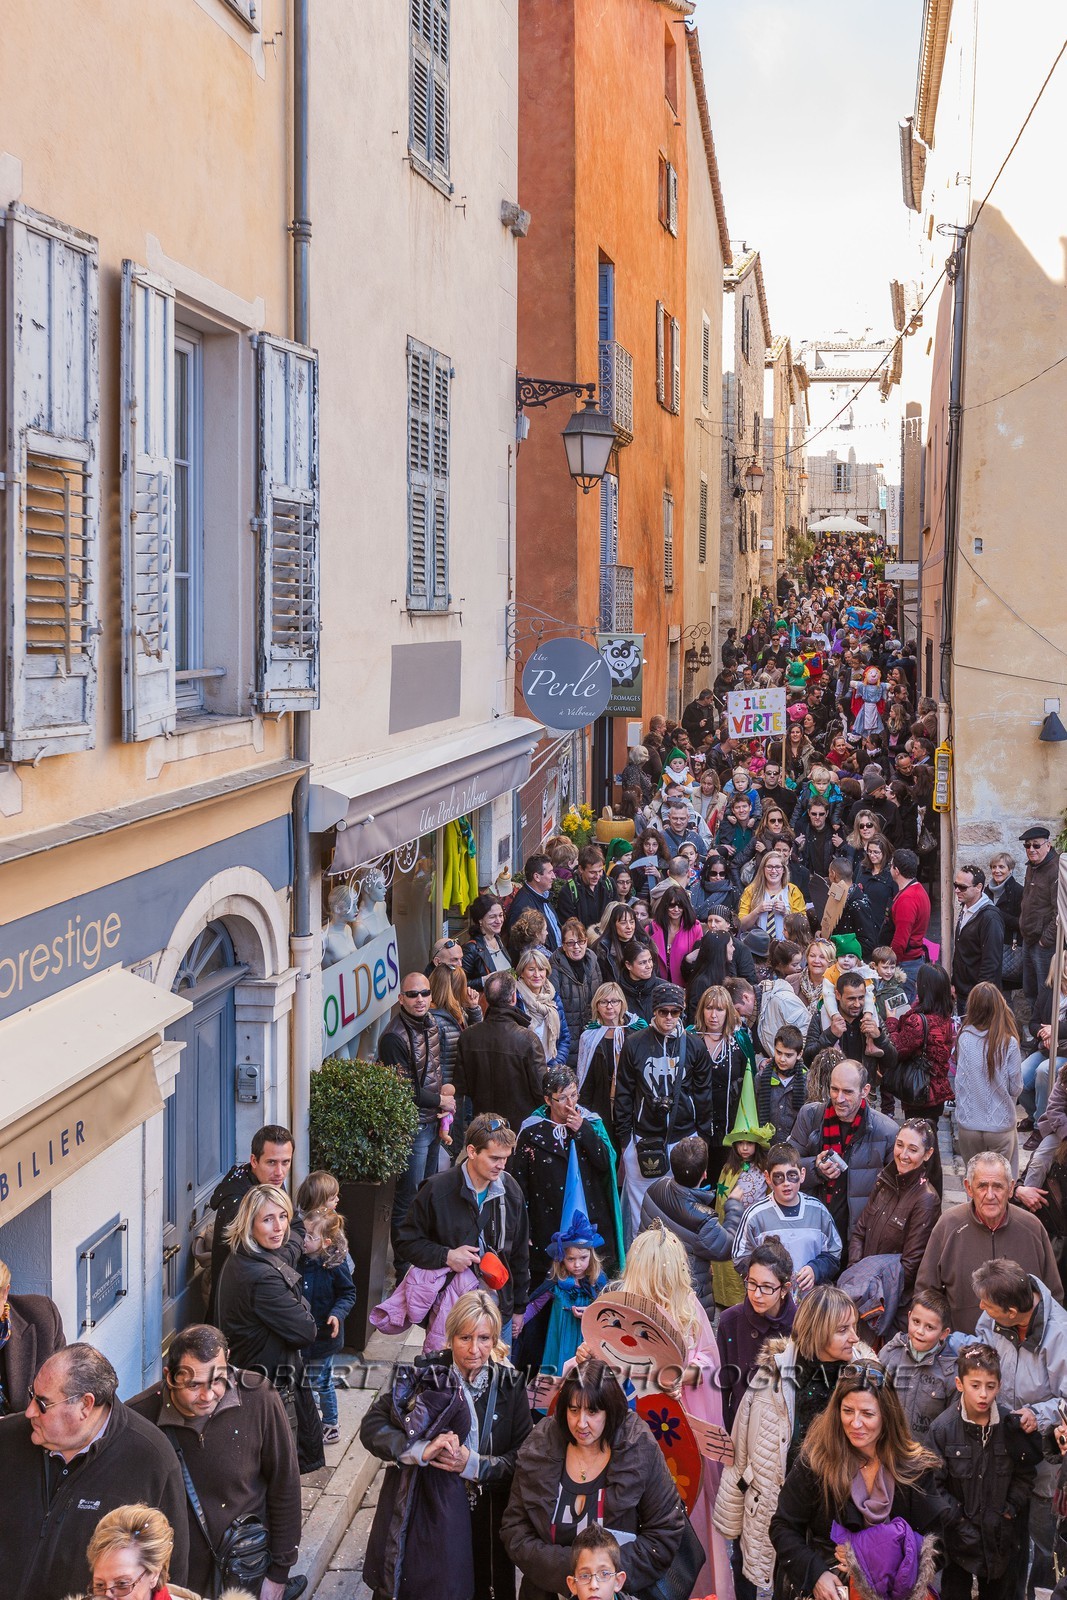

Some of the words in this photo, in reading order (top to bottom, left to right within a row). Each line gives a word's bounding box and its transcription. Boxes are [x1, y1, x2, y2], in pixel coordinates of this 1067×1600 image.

[533, 653, 548, 661] Une
[527, 659, 602, 697] Perle
[610, 693, 641, 702] FROMAGES
[744, 695, 767, 710] ILE
[567, 706, 596, 717] Valbonne
[732, 712, 782, 734] VERTE
[419, 806, 435, 832] Une
[437, 786, 456, 824] Perle
[462, 776, 488, 812] Valbonne
[0, 1120, 85, 1201] BILIER
